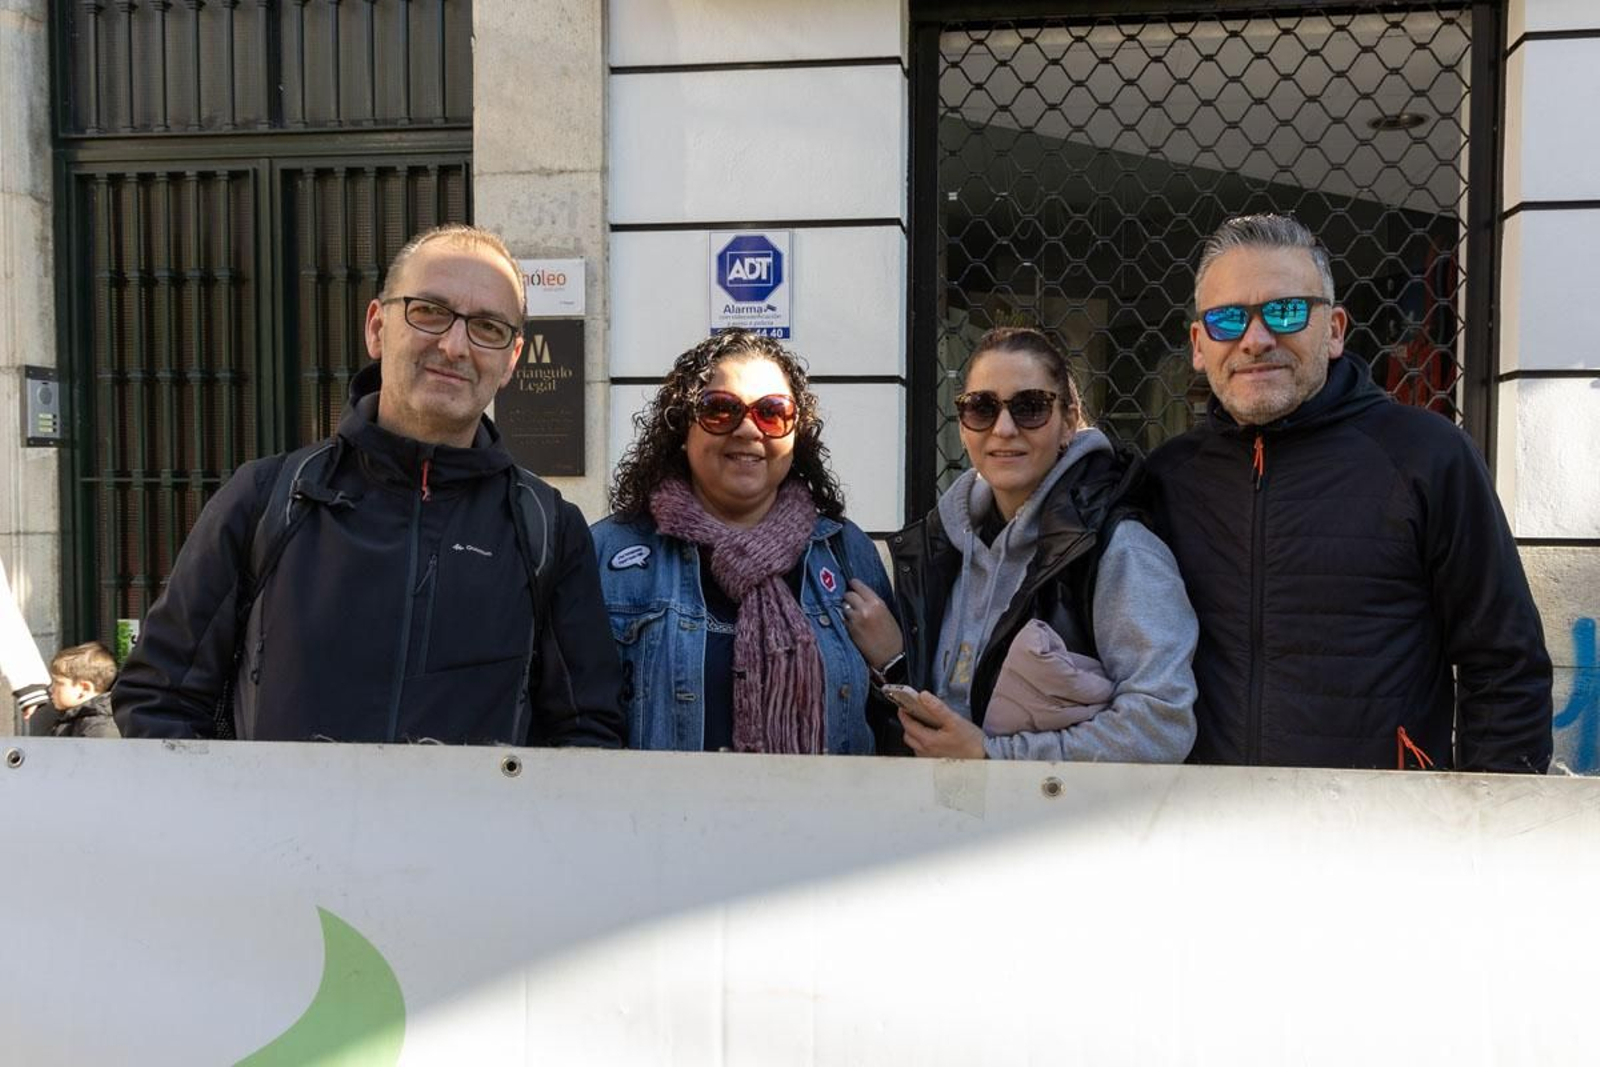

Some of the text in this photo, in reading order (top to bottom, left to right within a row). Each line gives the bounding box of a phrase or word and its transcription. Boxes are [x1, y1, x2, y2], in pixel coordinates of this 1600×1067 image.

[727, 256, 773, 281] ADT
[723, 304, 763, 314] Alarma
[770, 328, 784, 338] 40
[520, 379, 557, 395] Legal
